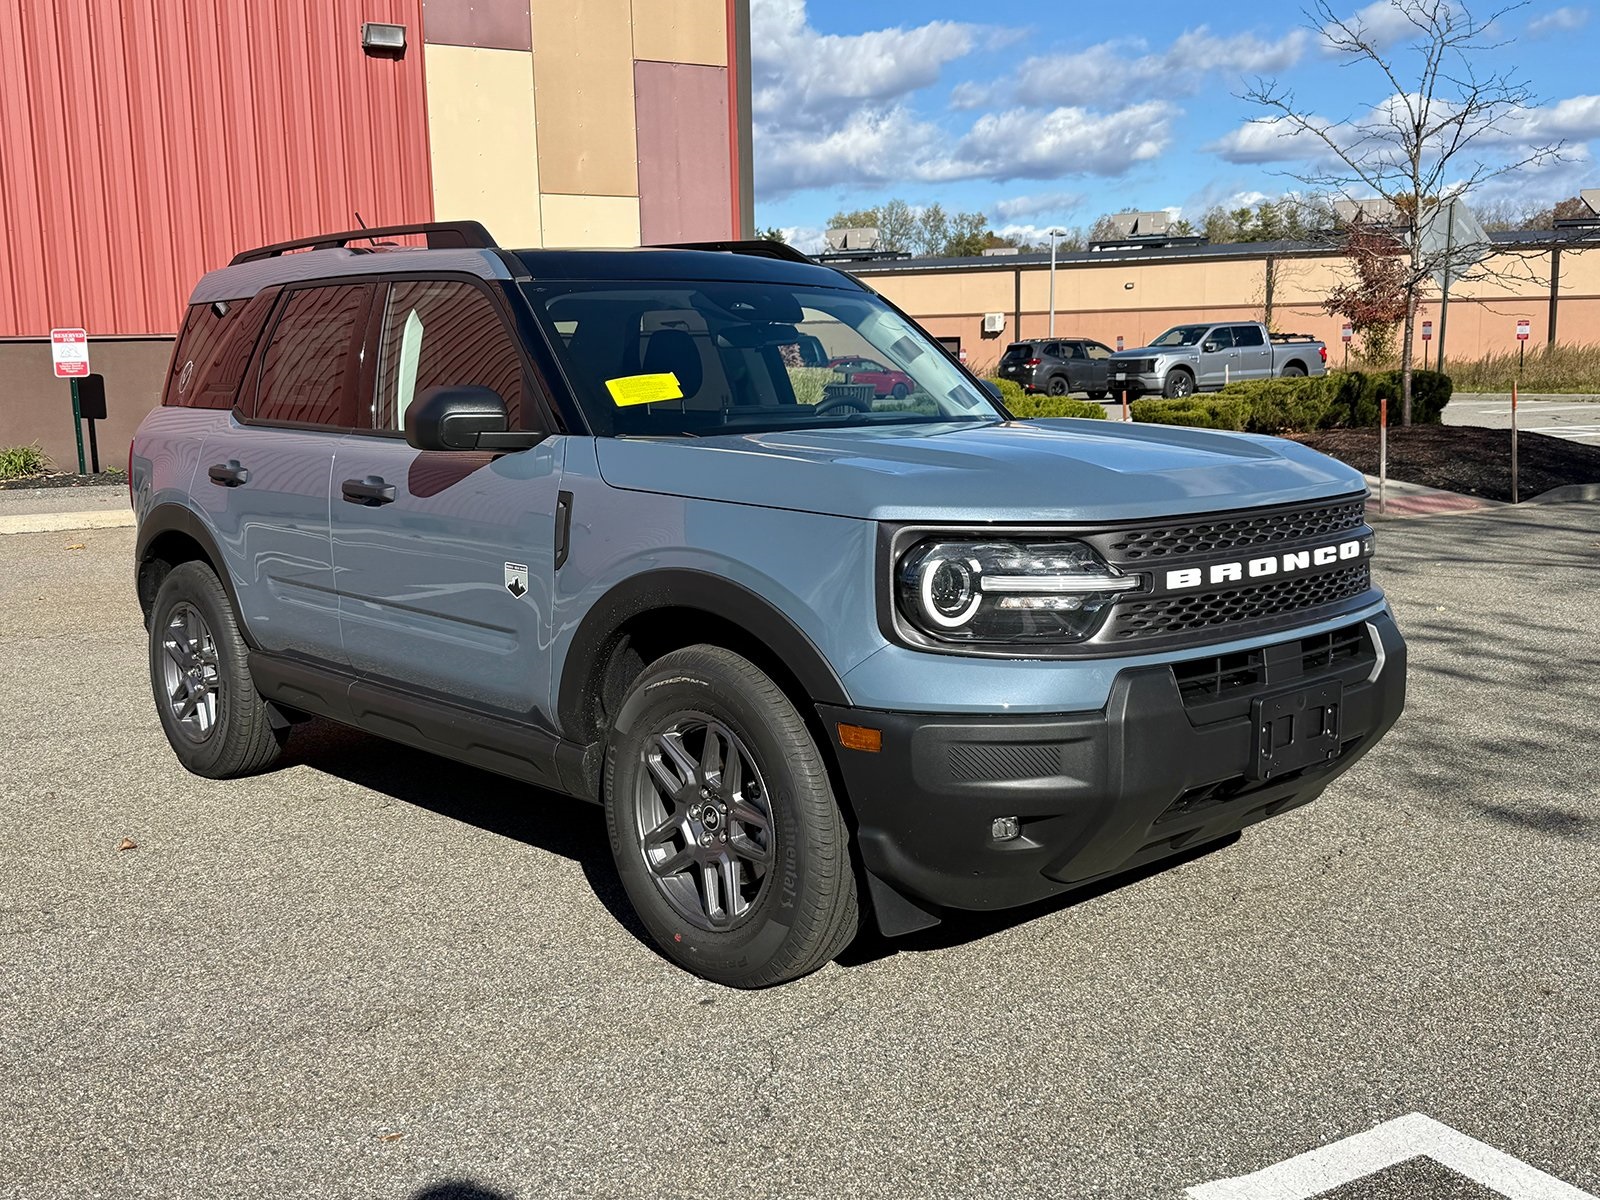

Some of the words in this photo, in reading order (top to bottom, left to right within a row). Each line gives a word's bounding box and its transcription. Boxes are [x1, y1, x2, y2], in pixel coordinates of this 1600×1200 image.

[1166, 540, 1360, 590] BRONCO
[605, 756, 622, 856] Continental
[778, 788, 798, 897] Continental
